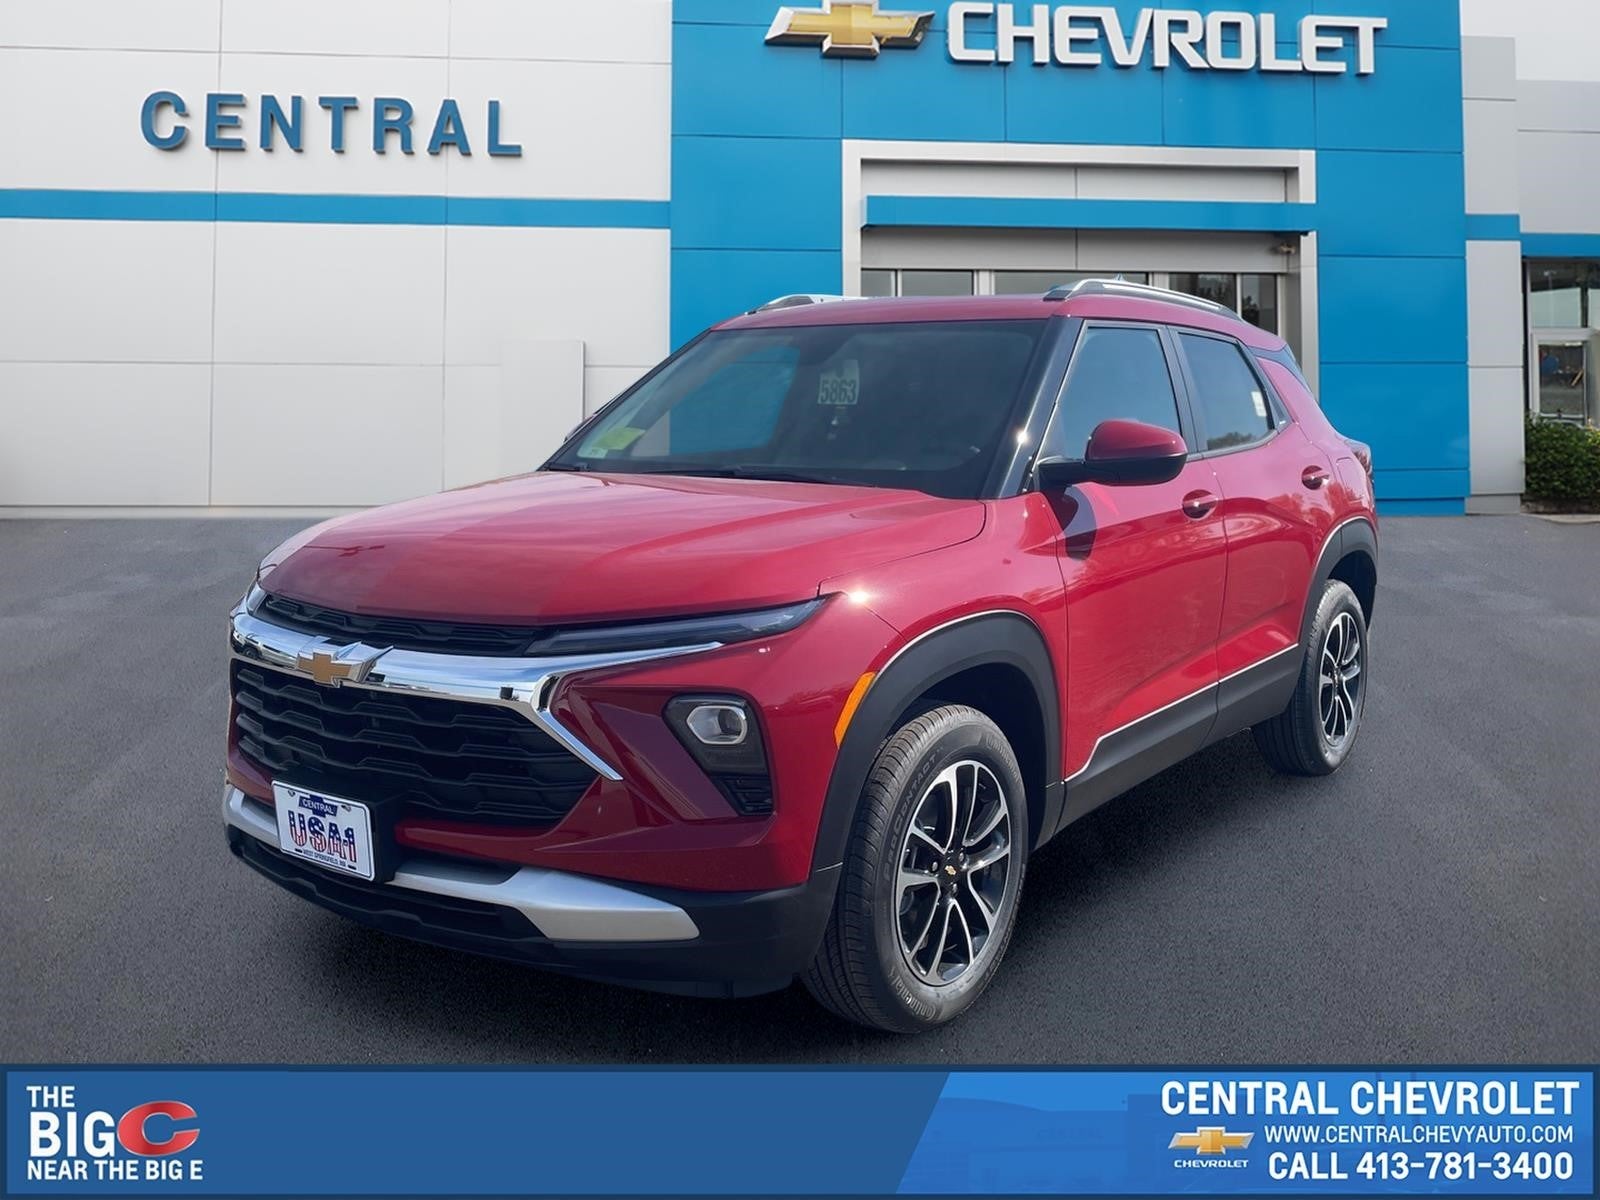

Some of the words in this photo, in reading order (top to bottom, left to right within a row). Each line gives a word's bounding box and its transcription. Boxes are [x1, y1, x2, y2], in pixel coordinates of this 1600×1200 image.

[947, 1, 1388, 75] CHEVROLET
[139, 90, 522, 158] CENTRAL
[820, 379, 857, 402] 5863
[302, 798, 335, 815] CENTRAL
